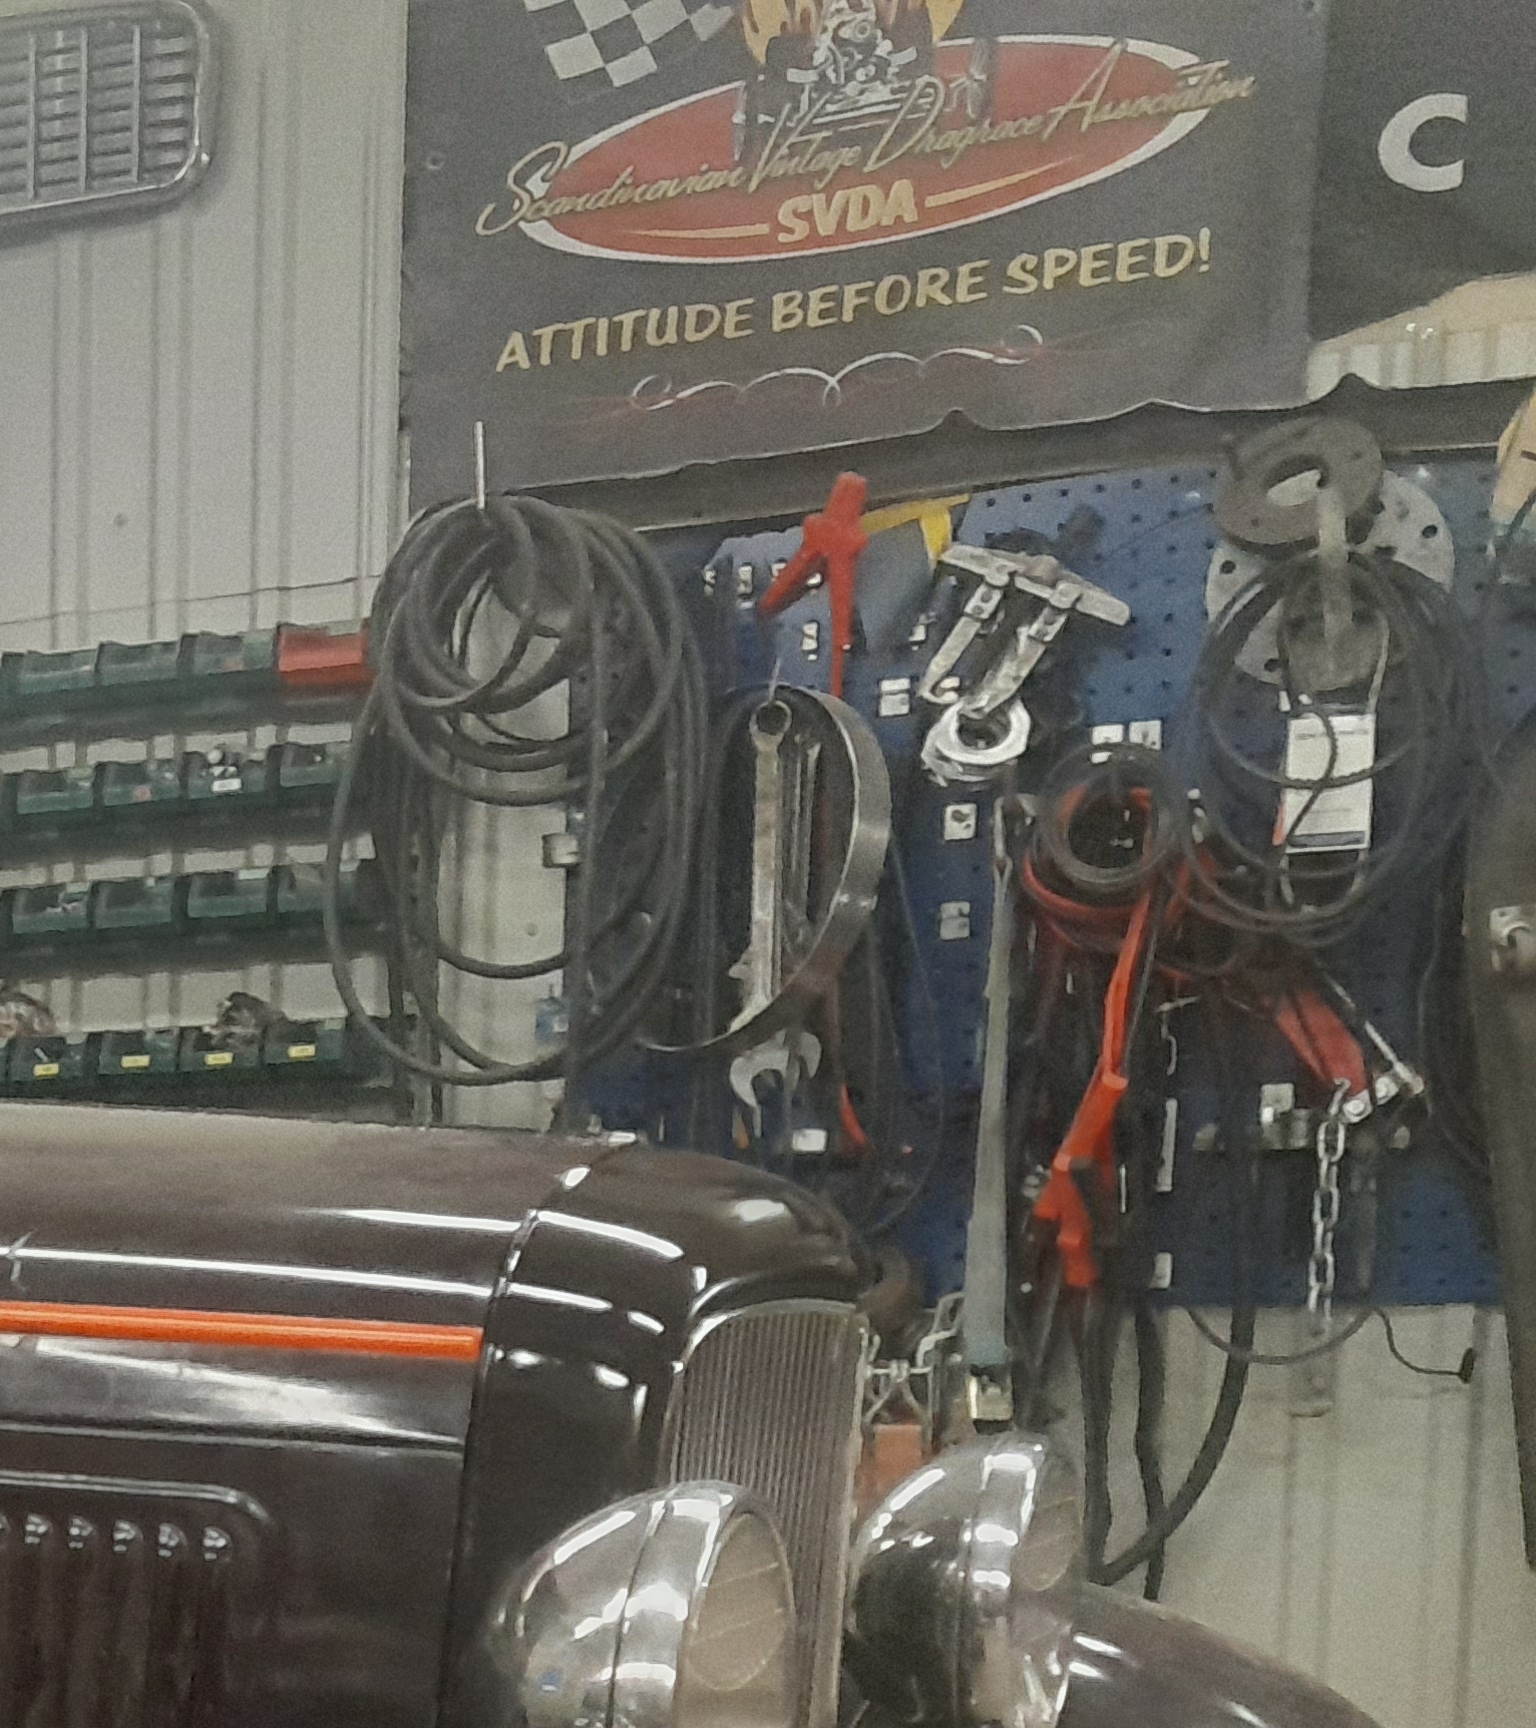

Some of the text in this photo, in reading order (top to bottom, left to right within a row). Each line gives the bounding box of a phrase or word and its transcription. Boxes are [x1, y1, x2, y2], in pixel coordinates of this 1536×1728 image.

[1378, 92, 1468, 193] C
[777, 178, 918, 243] SVDA
[495, 226, 1211, 372] ATTITUDE BEFORE SPEED!
